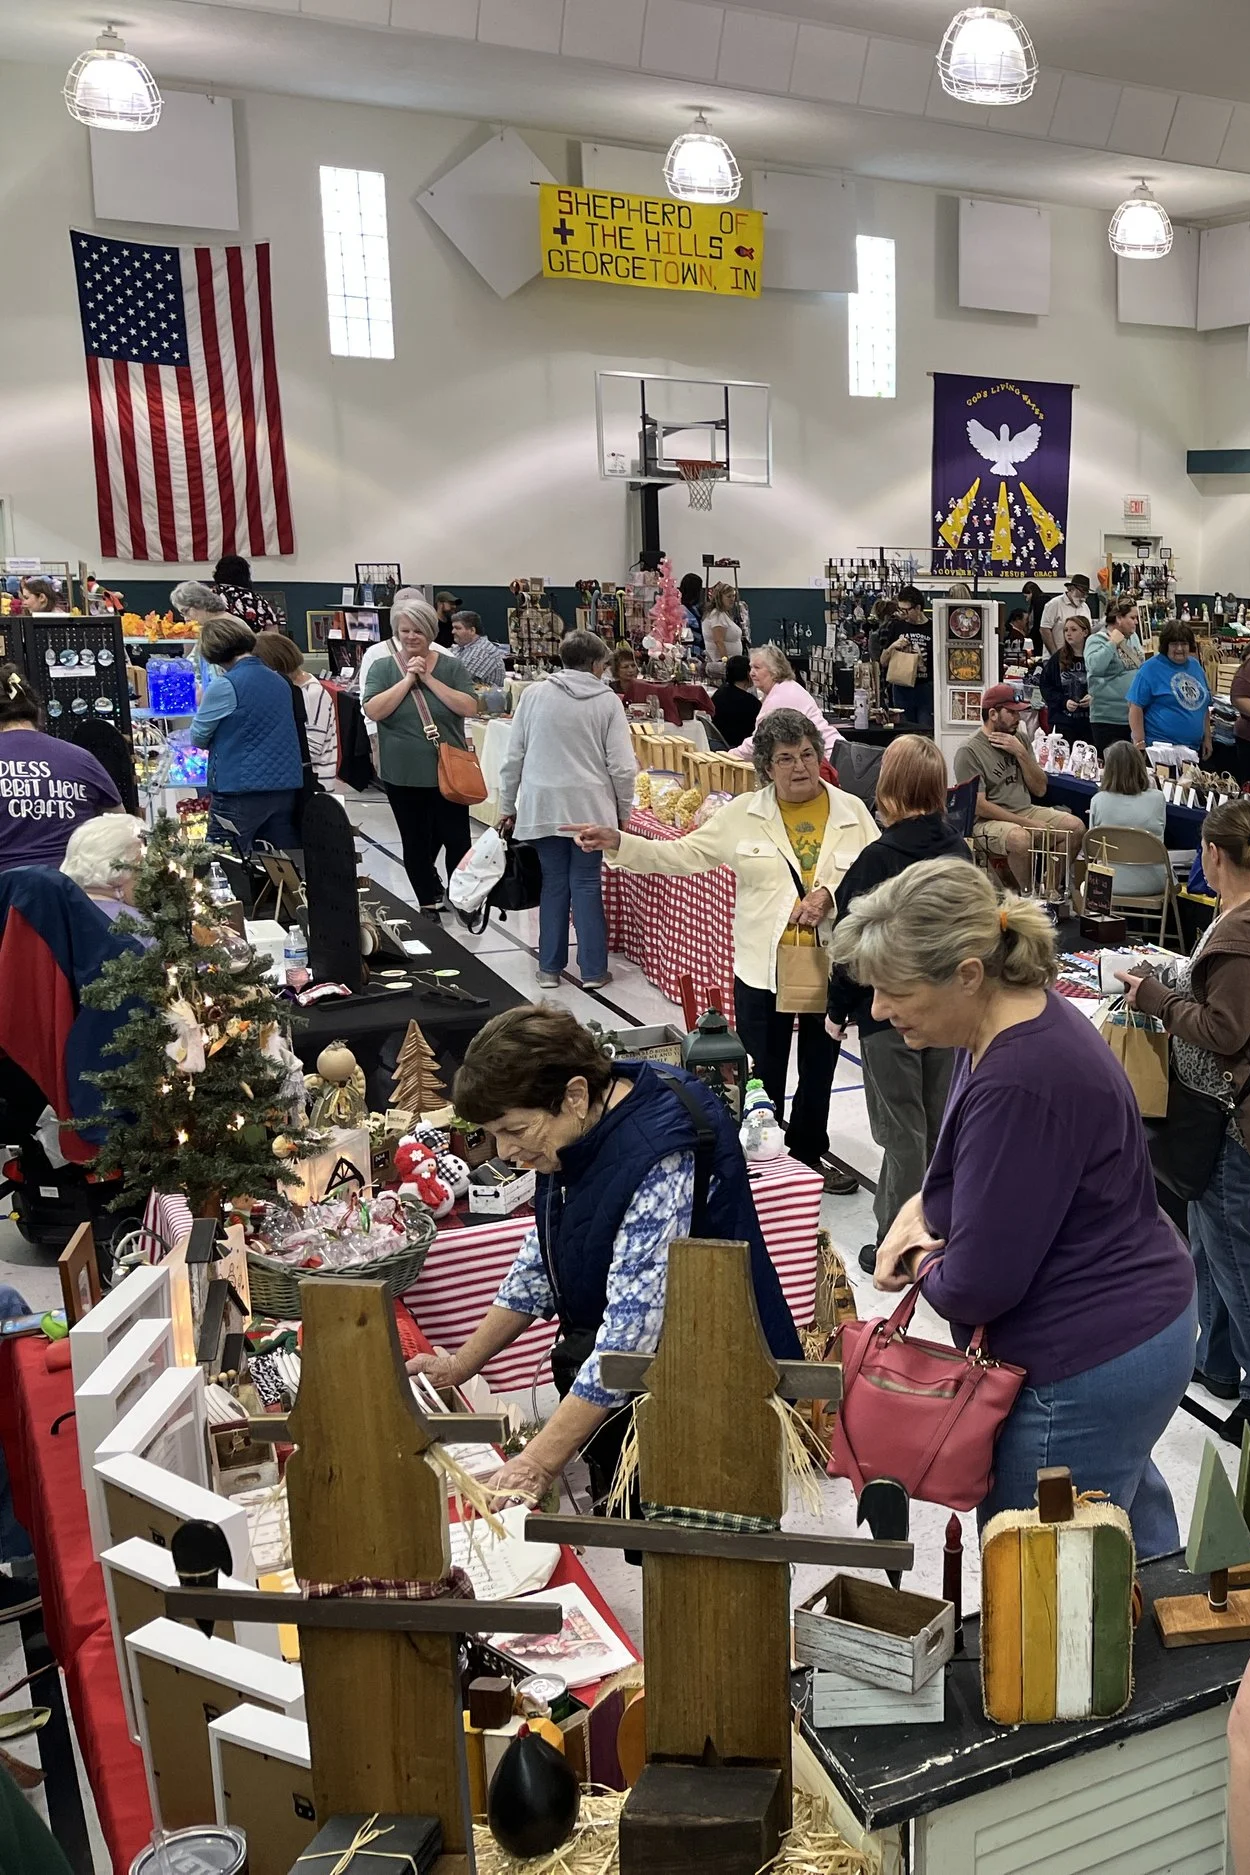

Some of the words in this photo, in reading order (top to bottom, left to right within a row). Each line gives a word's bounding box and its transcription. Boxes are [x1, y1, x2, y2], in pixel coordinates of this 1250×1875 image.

[557, 190, 692, 229] SHEPHERD
[719, 211, 749, 235] OF
[585, 222, 634, 250] THE
[646, 230, 722, 260] HILLS
[548, 249, 717, 291] GEORGETOWN,
[730, 266, 756, 292] IN
[991, 382, 1020, 395] LIVING
[1022, 394, 1044, 420] WATER
[1130, 500, 1144, 513] EXIT
[48, 779, 88, 801] HOLE
